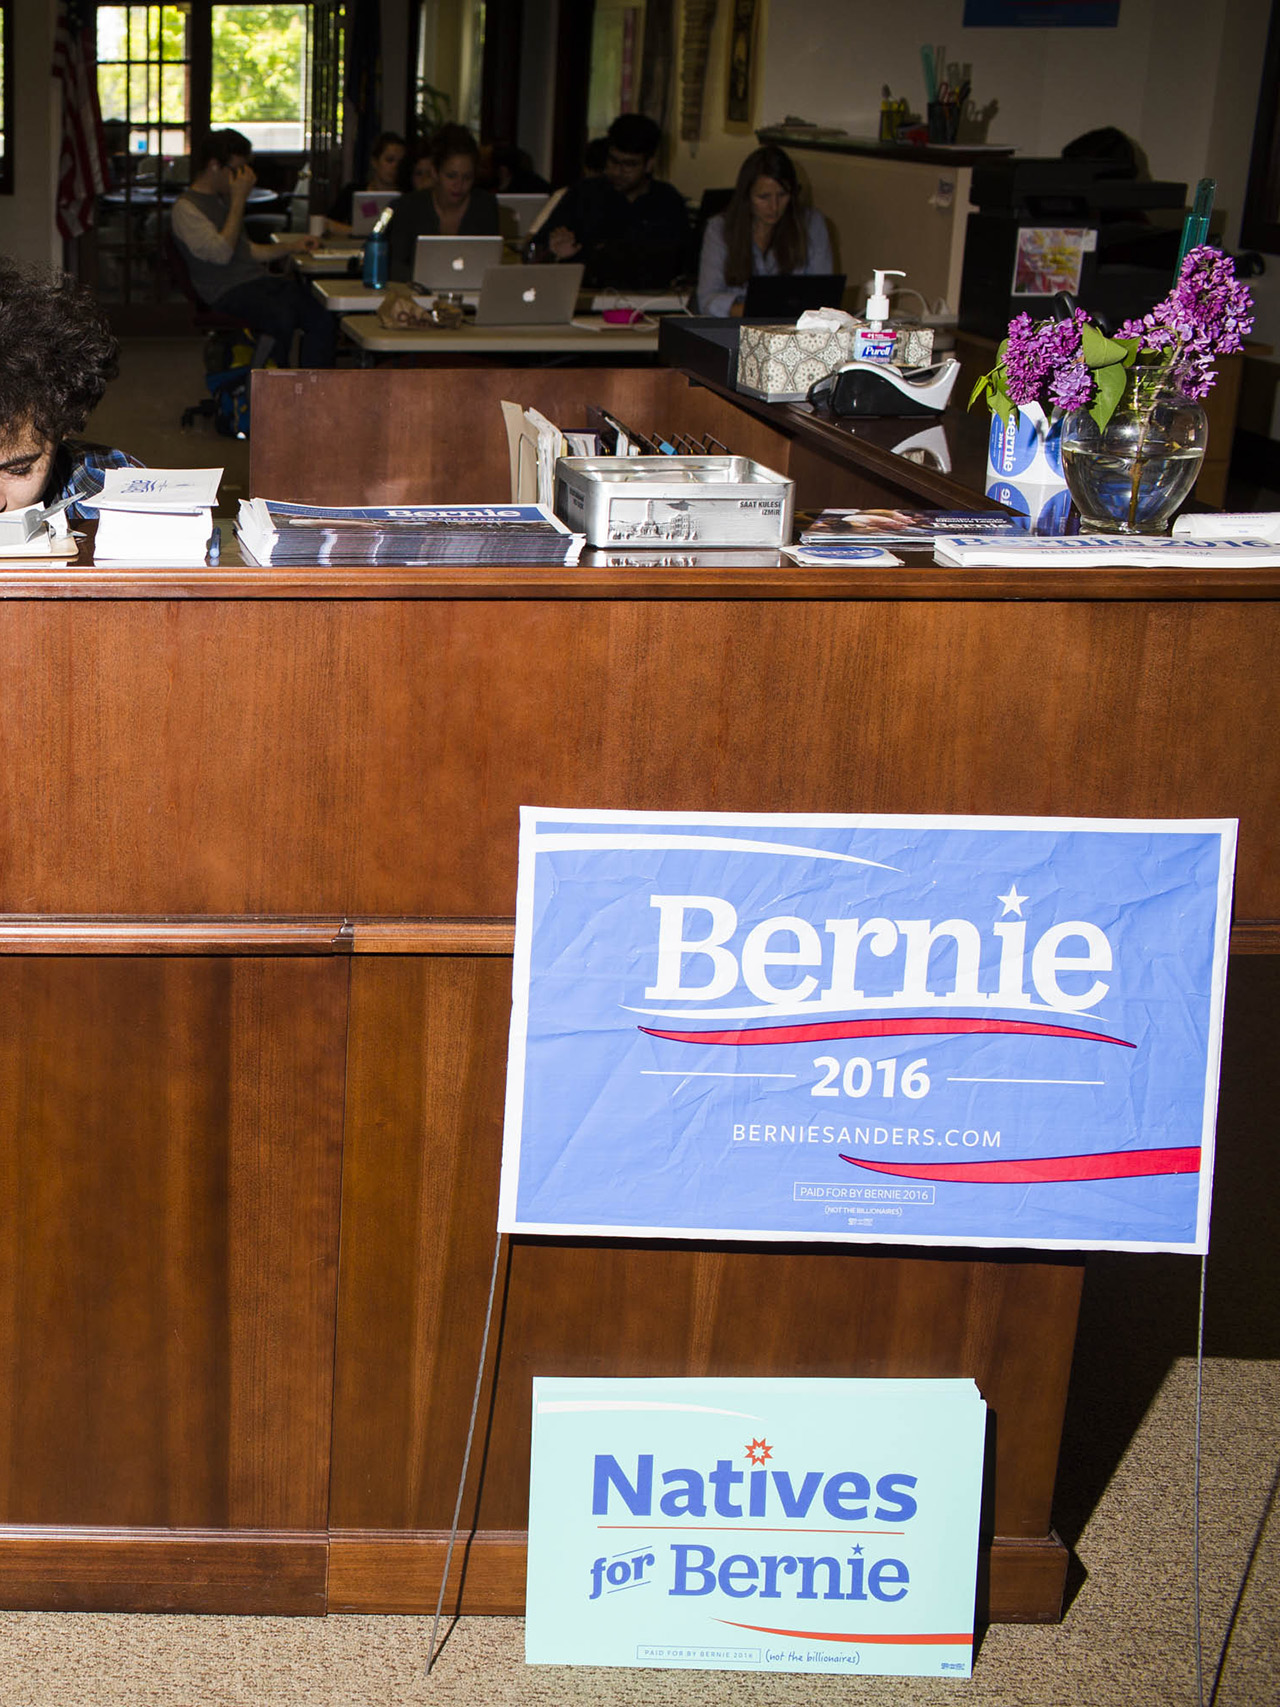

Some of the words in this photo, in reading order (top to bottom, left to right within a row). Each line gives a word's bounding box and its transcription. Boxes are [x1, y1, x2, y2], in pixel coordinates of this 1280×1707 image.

[865, 346, 891, 356] Purell
[384, 508, 521, 518] Bernie
[946, 537, 1146, 548] Bernie
[1153, 538, 1272, 548] 2016
[642, 884, 1114, 1012] Bernie
[810, 1056, 931, 1100] 2016
[733, 1123, 1002, 1149] BERNIESANDERS.COM
[800, 1187, 824, 1197] PAID
[825, 1187, 848, 1198] FOR
[849, 1188, 862, 1198] BY
[864, 1189, 901, 1200] BERNIE
[903, 1190, 929, 1201] 2016
[842, 1206, 855, 1214] THE
[592, 1437, 918, 1522] Natives
[589, 1553, 655, 1600] for
[668, 1542, 910, 1602] Bernie
[765, 1648, 785, 1663] (not
[788, 1650, 803, 1663] the
[806, 1651, 861, 1665] billionaires)
